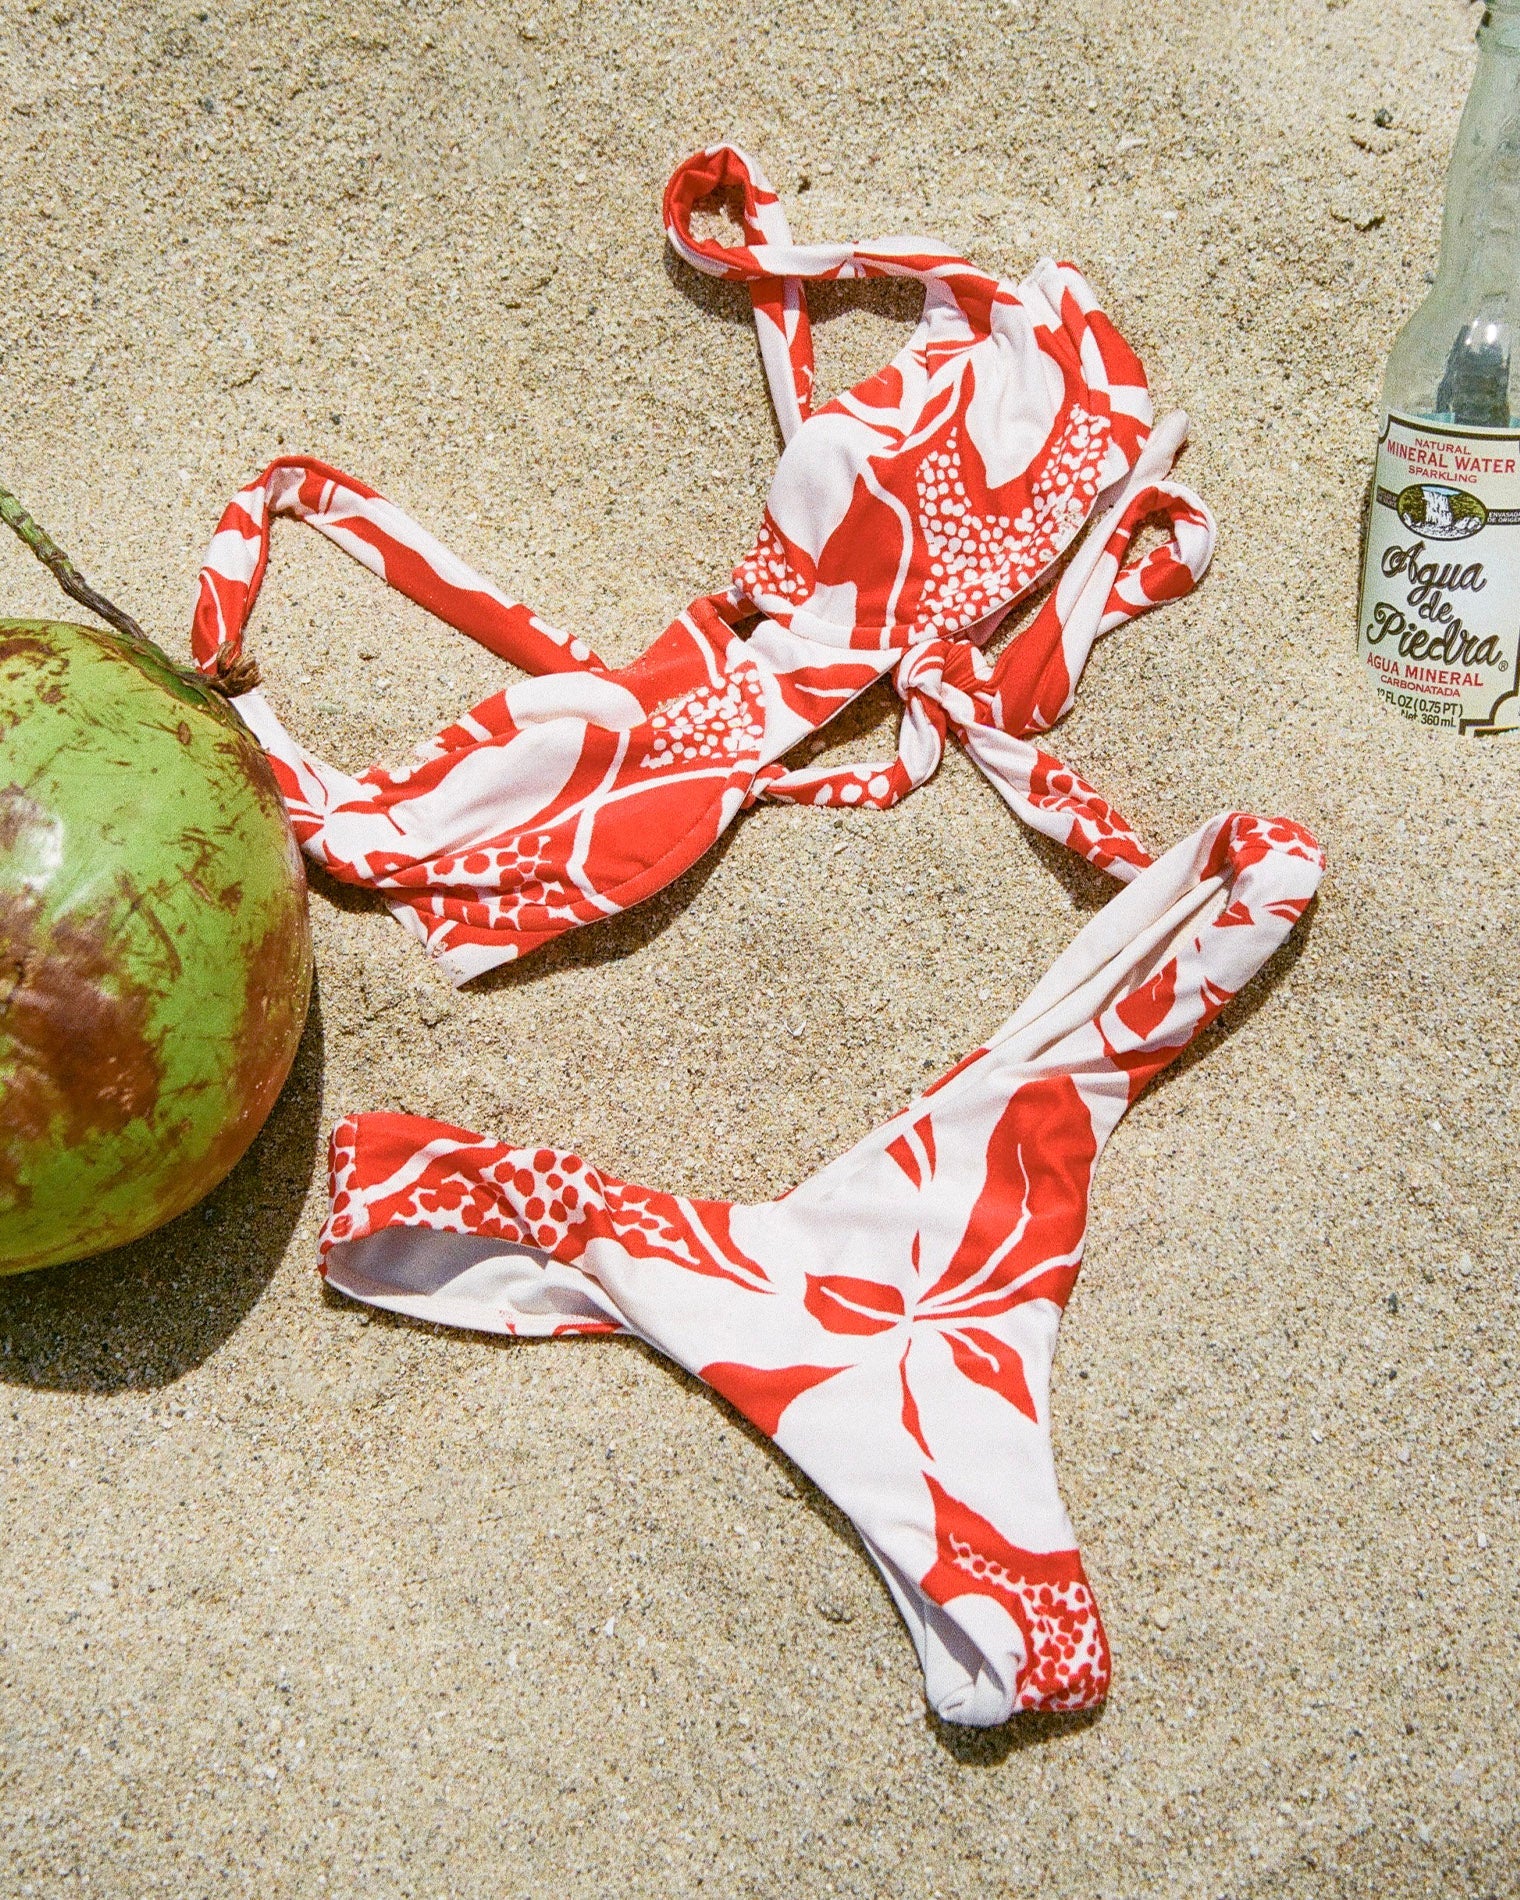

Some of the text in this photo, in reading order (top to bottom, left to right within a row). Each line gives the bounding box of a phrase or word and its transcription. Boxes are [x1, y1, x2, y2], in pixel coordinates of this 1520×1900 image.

[1387, 439, 1516, 473] MINERAL WATER
[1415, 438, 1471, 455] NATURAL
[1408, 465, 1478, 484] SPARKLING
[1381, 540, 1487, 606] Agua
[1418, 590, 1454, 624] de
[1366, 651, 1484, 687] AGUA MINERAL
[1380, 675, 1461, 697] CARBONATADA
[1397, 694, 1413, 709] OZ
[1420, 713, 1440, 726] 360
